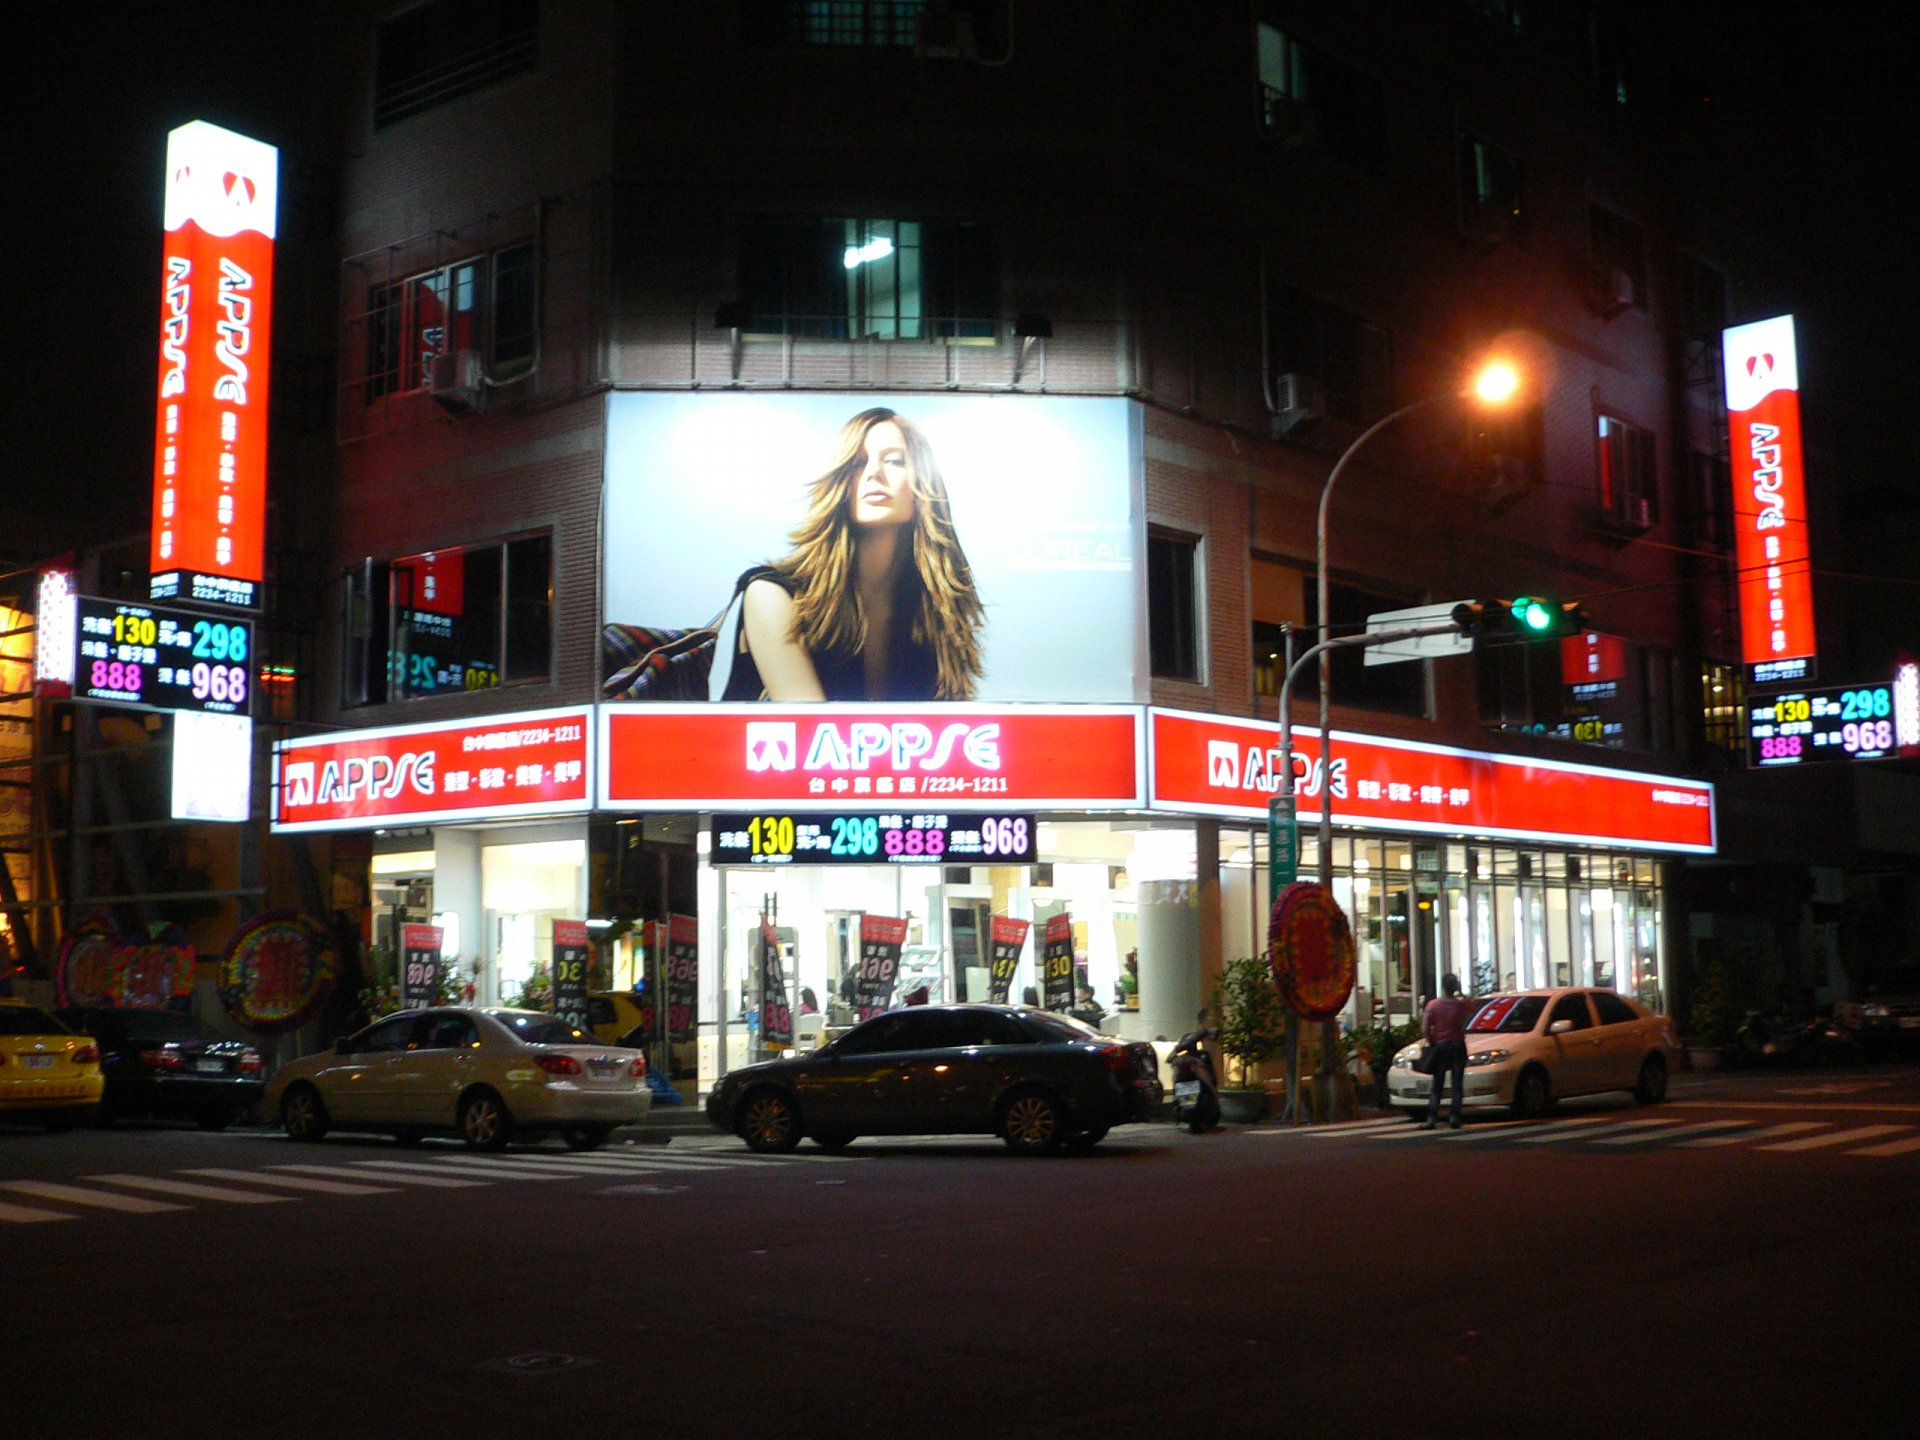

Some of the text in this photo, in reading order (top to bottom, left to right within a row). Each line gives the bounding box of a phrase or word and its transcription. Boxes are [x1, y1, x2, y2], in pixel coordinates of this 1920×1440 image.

[192, 587, 251, 605] 2234-1211
[112, 614, 156, 646] 130
[193, 621, 248, 661] 298
[91, 660, 142, 692] 888
[192, 663, 246, 703] 968
[1774, 700, 1810, 722] 130
[1841, 688, 1891, 720] 298
[803, 722, 1001, 771] APPSE
[1761, 736, 1803, 758] 888
[1843, 720, 1893, 752] 968
[748, 816, 794, 856] 130
[830, 817, 878, 856] 298
[884, 828, 945, 856] 888
[981, 817, 1029, 856] 968
